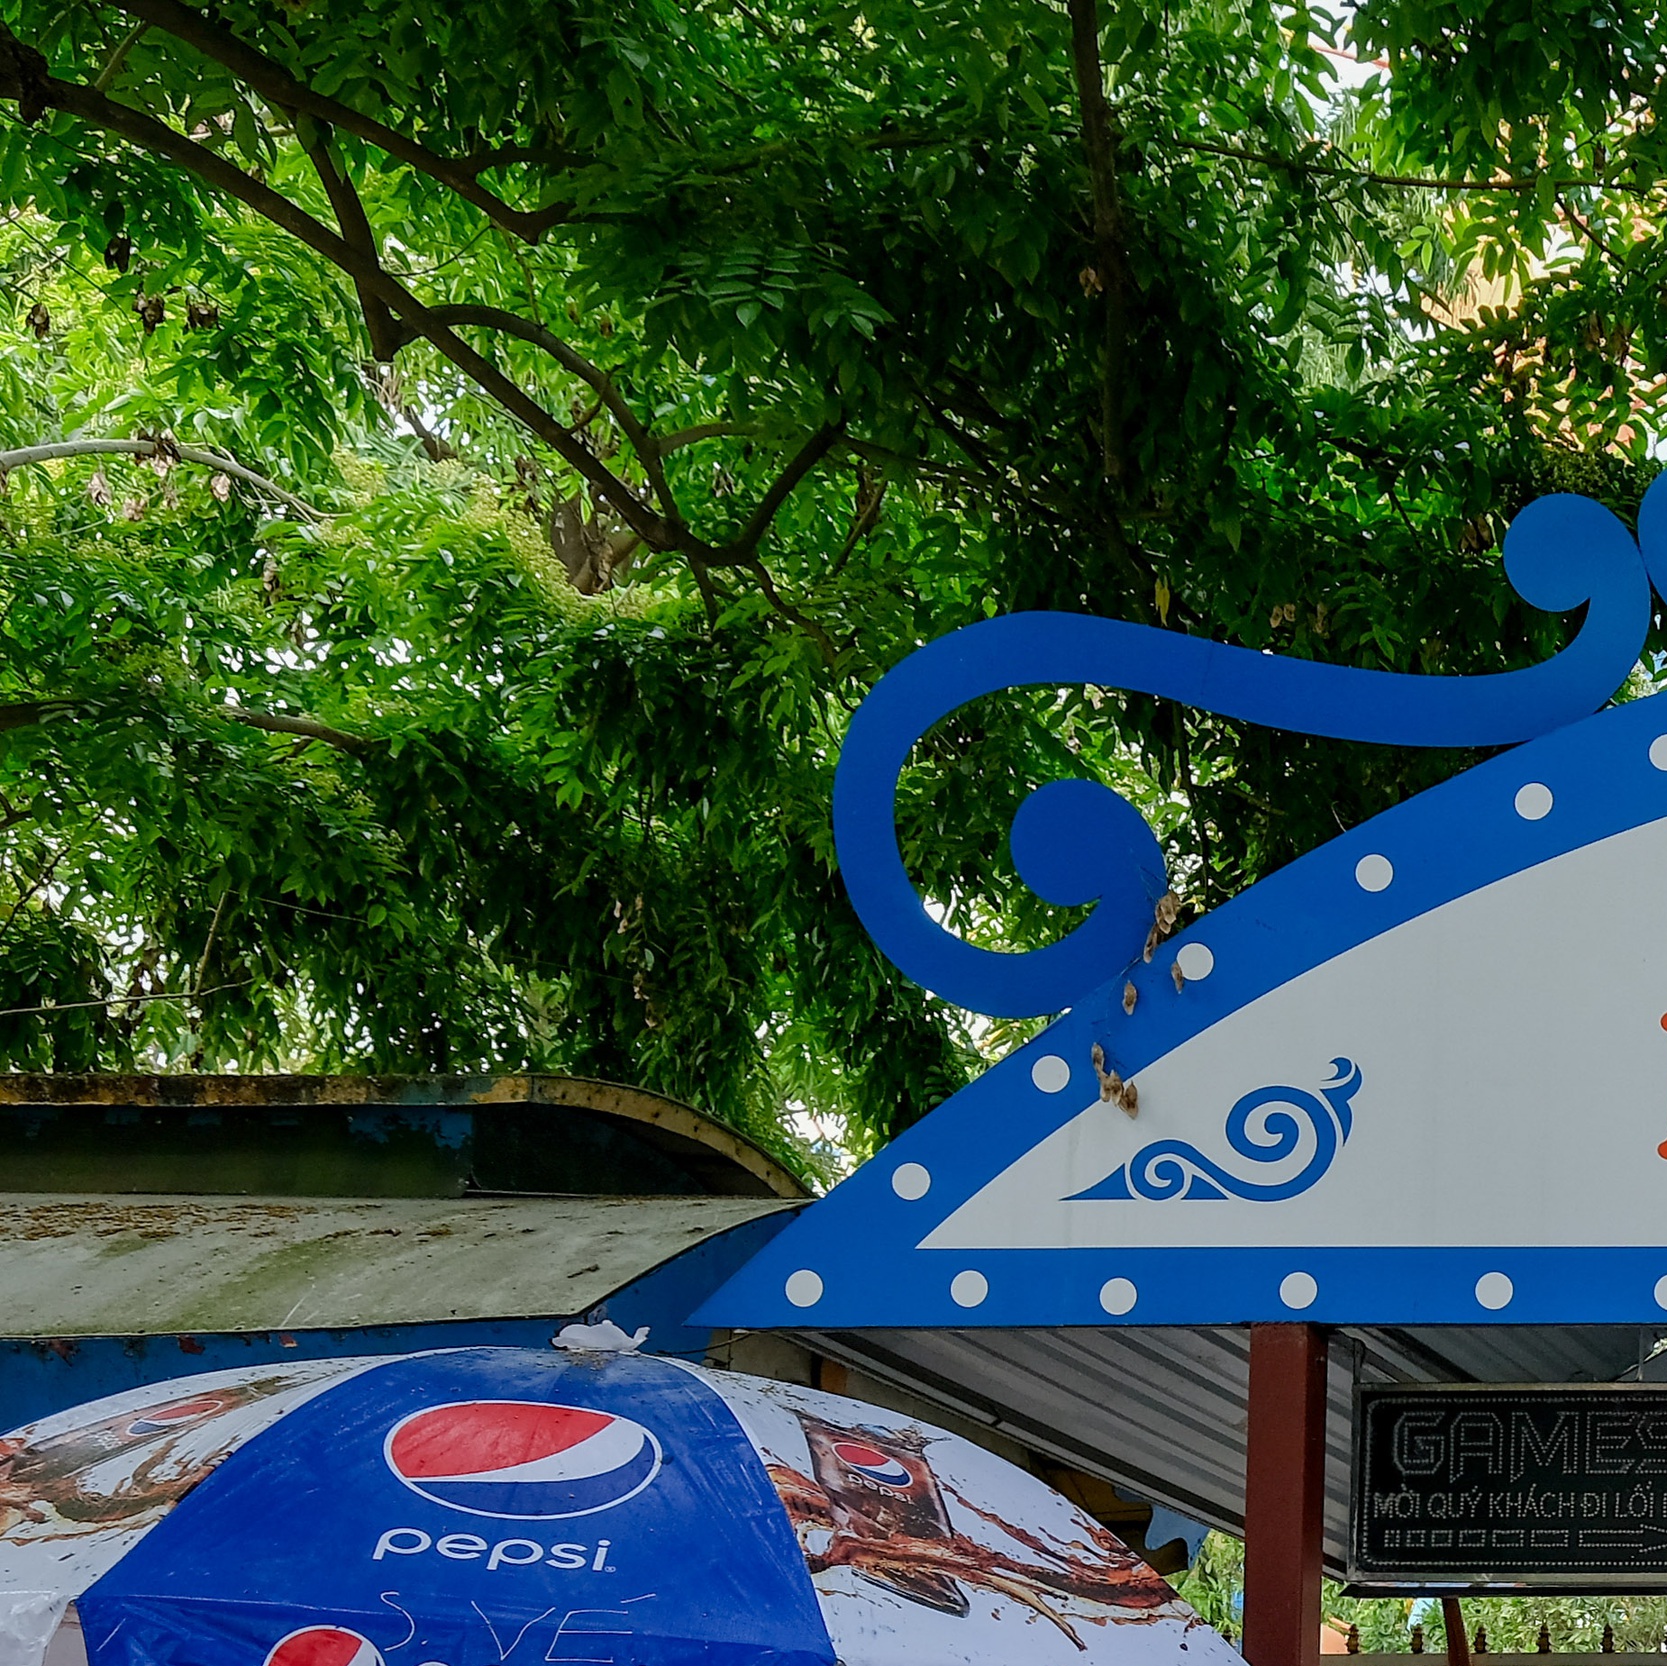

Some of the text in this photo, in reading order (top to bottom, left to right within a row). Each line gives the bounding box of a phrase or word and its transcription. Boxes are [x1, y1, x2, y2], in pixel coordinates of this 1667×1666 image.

[848, 1474, 915, 1505] pepsi
[1488, 1483, 1575, 1519] KHÁCH
[1580, 1491, 1607, 1518] ĐI
[1614, 1480, 1653, 1518] LỐI
[371, 1527, 611, 1572] pepsi
